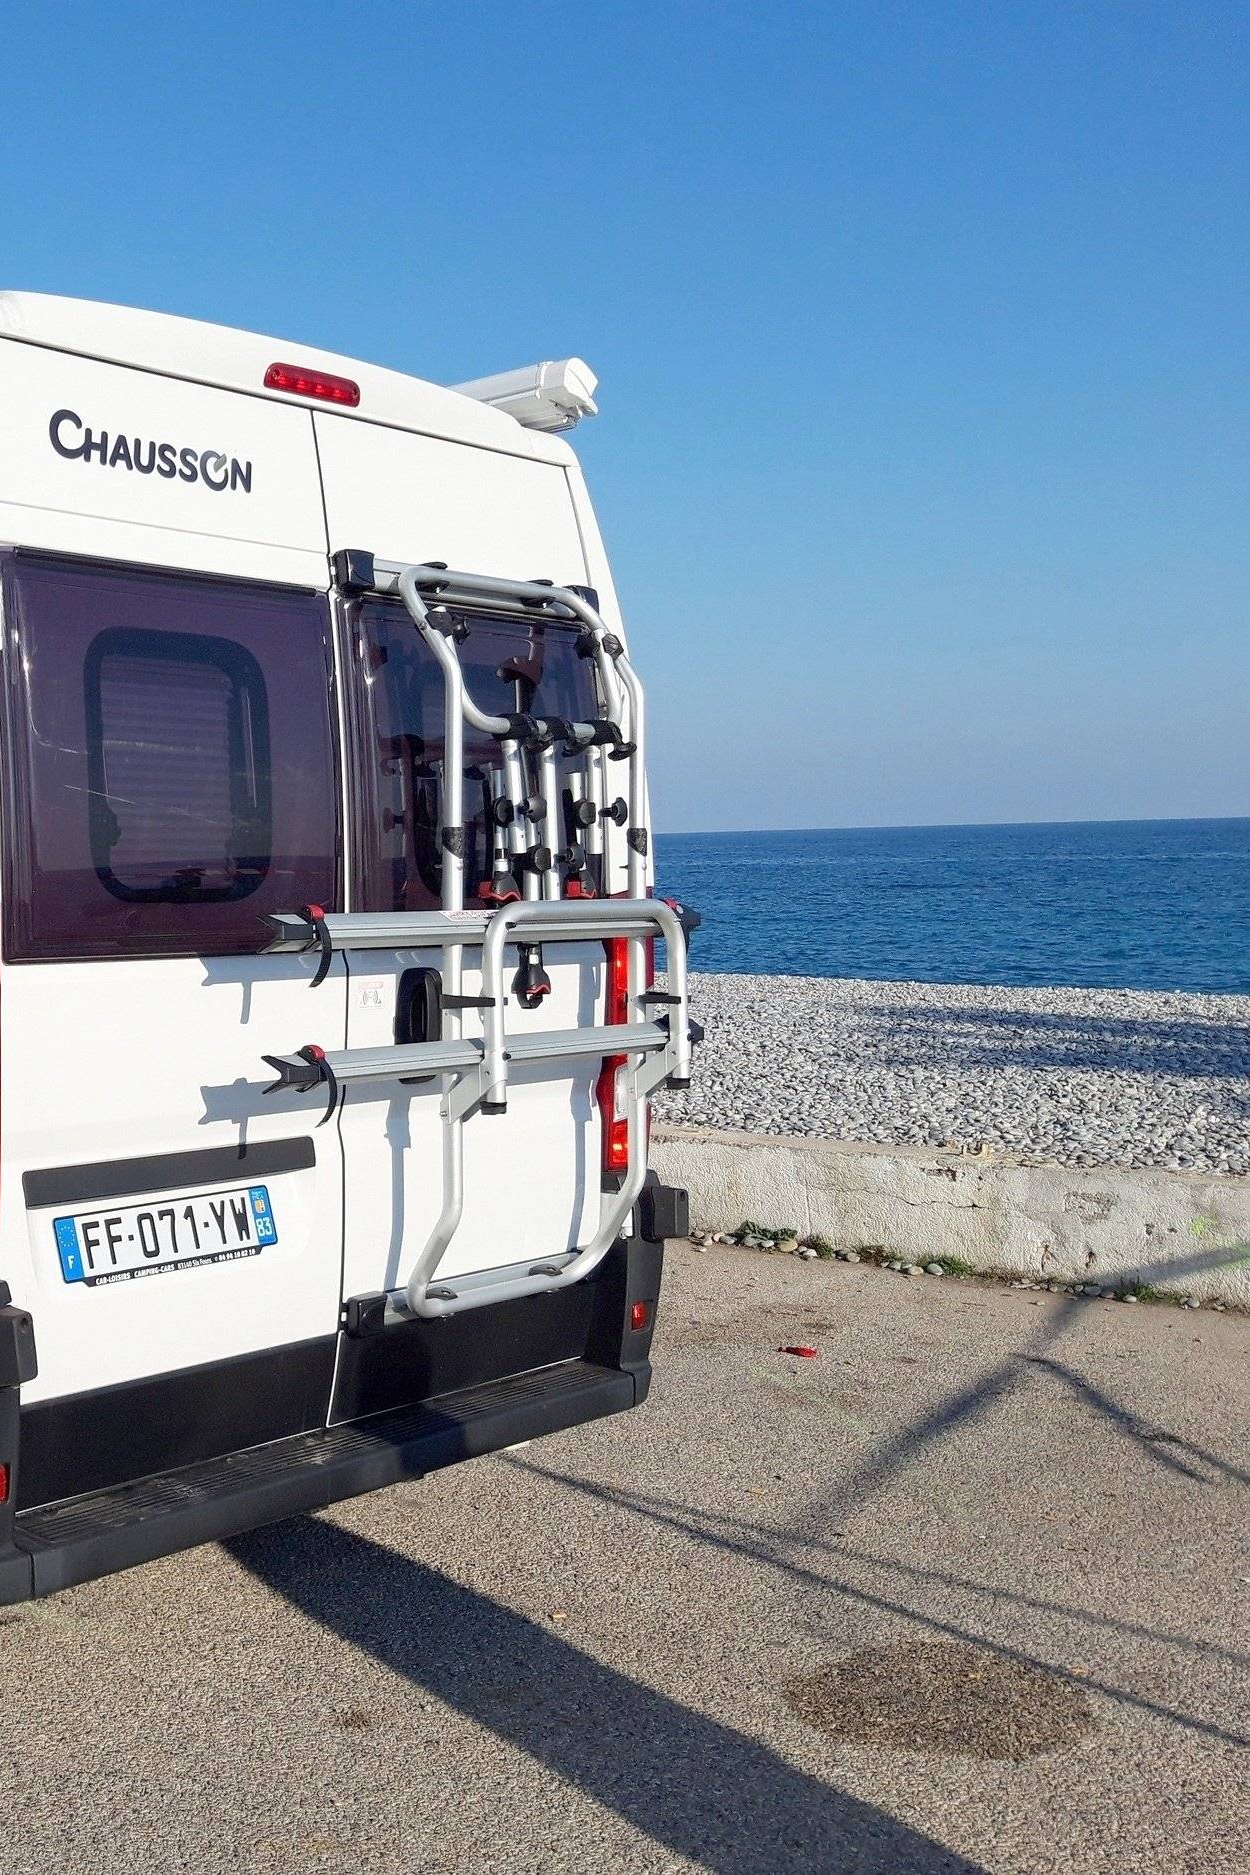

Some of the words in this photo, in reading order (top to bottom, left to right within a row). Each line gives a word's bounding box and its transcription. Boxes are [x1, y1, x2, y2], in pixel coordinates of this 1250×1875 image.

[49, 408, 252, 494] CHAUSSON
[81, 1196, 251, 1269] FF-071-YW
[255, 1216, 273, 1237] 83
[68, 1254, 75, 1270] F
